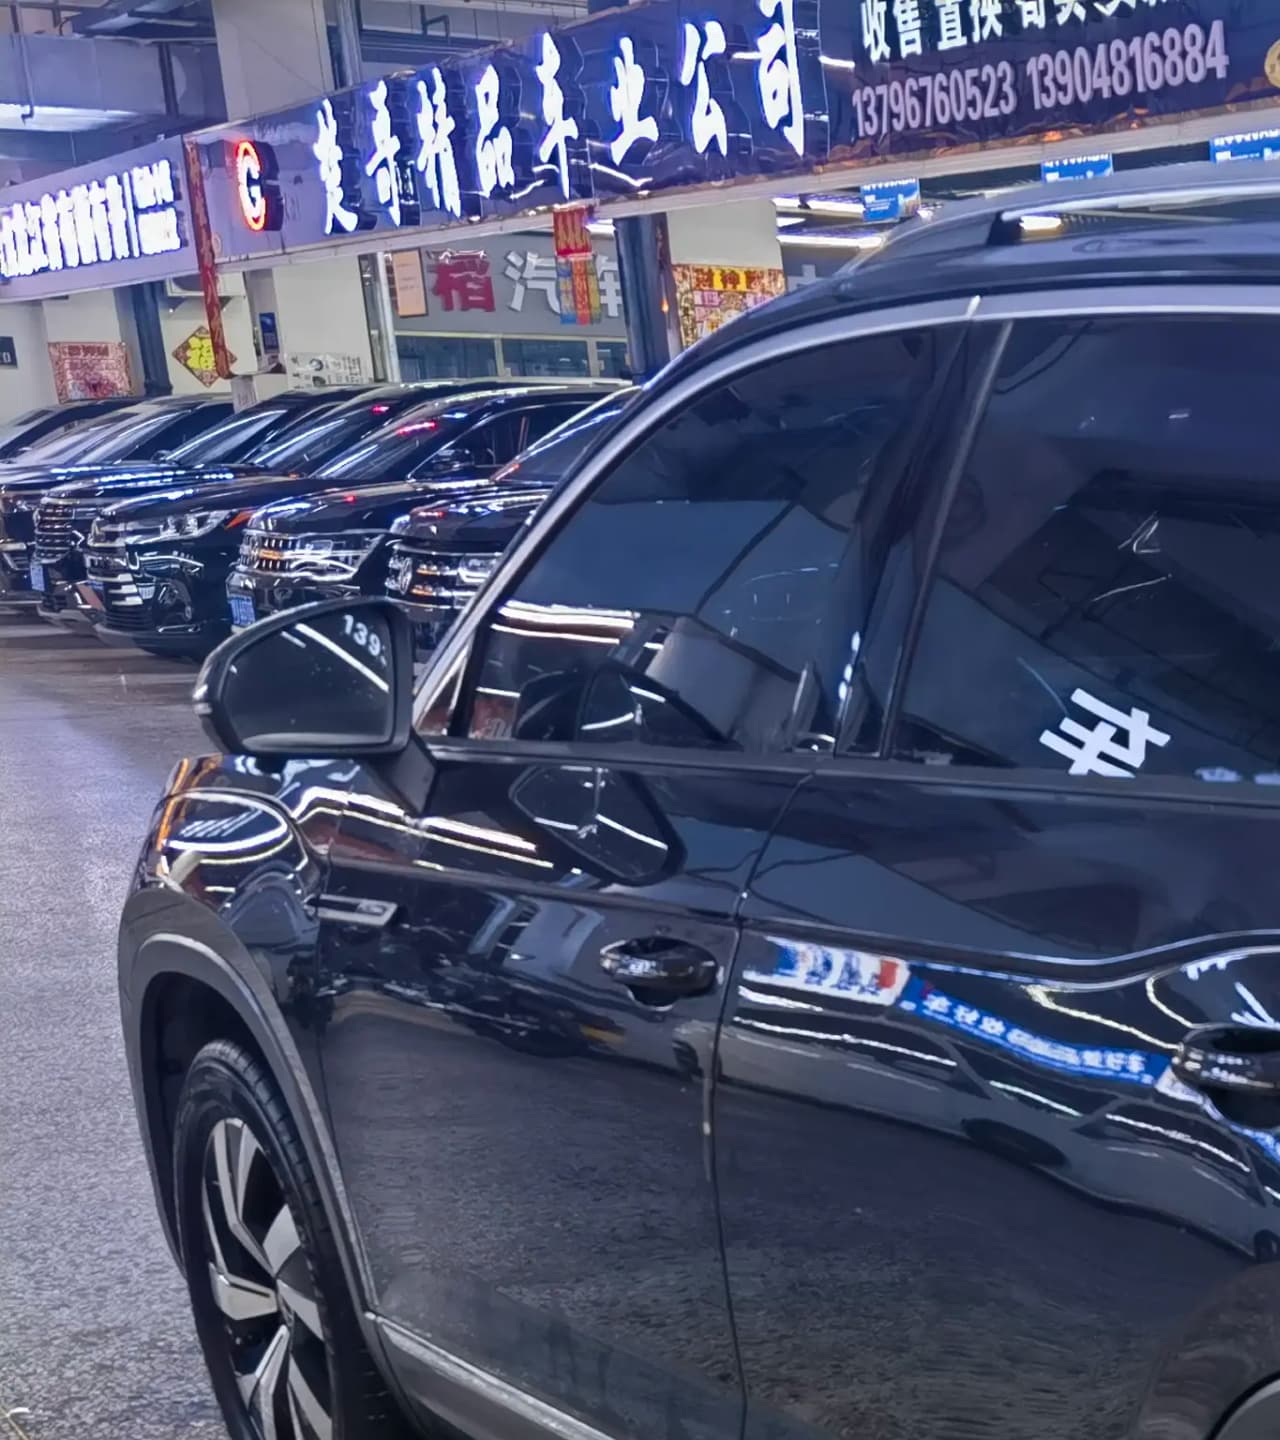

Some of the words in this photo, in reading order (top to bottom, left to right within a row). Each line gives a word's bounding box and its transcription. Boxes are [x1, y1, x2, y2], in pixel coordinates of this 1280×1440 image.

[852, 60, 1017, 138] 13796760523
[1026, 19, 1230, 110] 13904816884
[237, 142, 266, 231] G
